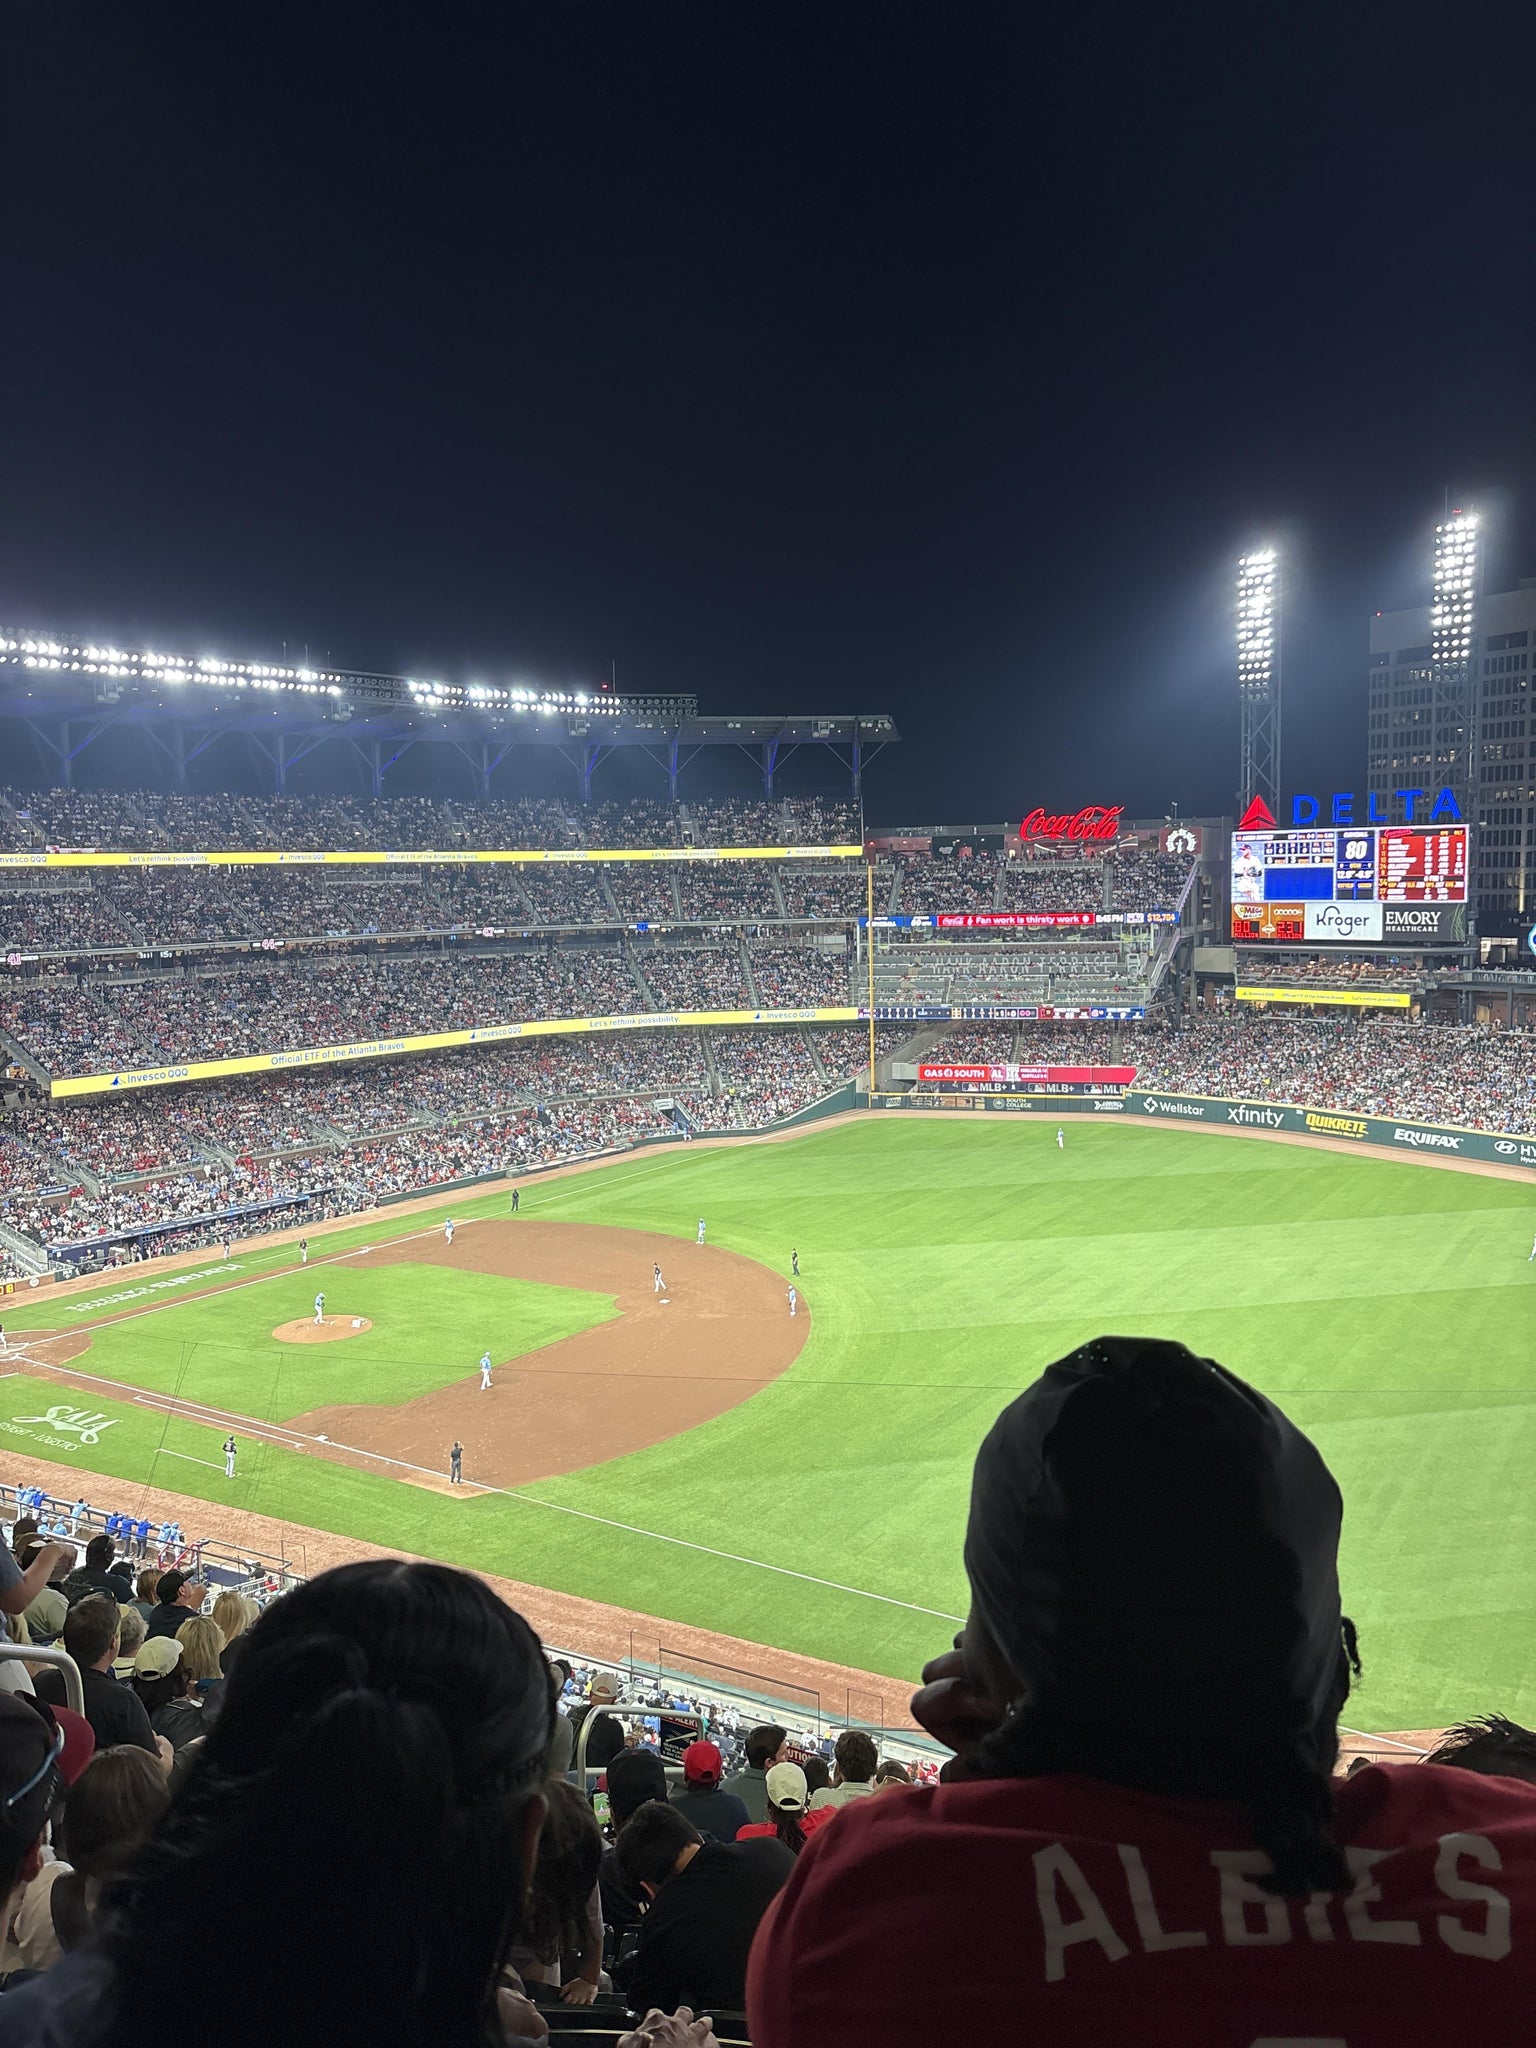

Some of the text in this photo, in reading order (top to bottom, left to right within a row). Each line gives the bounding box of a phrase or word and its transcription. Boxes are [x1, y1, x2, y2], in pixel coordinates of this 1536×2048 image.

[1292, 787, 1462, 825] DELTA
[1019, 806, 1125, 841] Coca-Cola
[1345, 841, 1367, 860] 80
[993, 916, 1014, 924] work
[1016, 915, 1024, 923] is
[1026, 915, 1054, 925] thirsty
[1056, 914, 1080, 923] work
[1316, 905, 1369, 935] Kroger
[1385, 911, 1441, 925] EMORY
[7, 953, 21, 965] 41
[932, 955, 1112, 974] HANK AARON TERRACE
[799, 1010, 816, 1018] QQQ
[589, 1019, 608, 1028] Let's
[609, 1017, 636, 1026] rethink
[480, 1026, 522, 1038] Invesco QQQ
[271, 1041, 405, 1066] Official ETF of the Atlanta Braves
[127, 1067, 189, 1083] Invesco QQQ
[924, 1069, 985, 1078] GAS SOUTH
[980, 1083, 1007, 1092] MLB+
[1046, 1083, 1075, 1093] MLB+
[1160, 1101, 1205, 1116] Wellstar
[1227, 1105, 1284, 1128] xfinity
[1306, 1113, 1368, 1132] QUIKRETE
[1394, 1128, 1459, 1149] EQUIFAX
[34, 1434, 82, 1451] LOGISTICS
